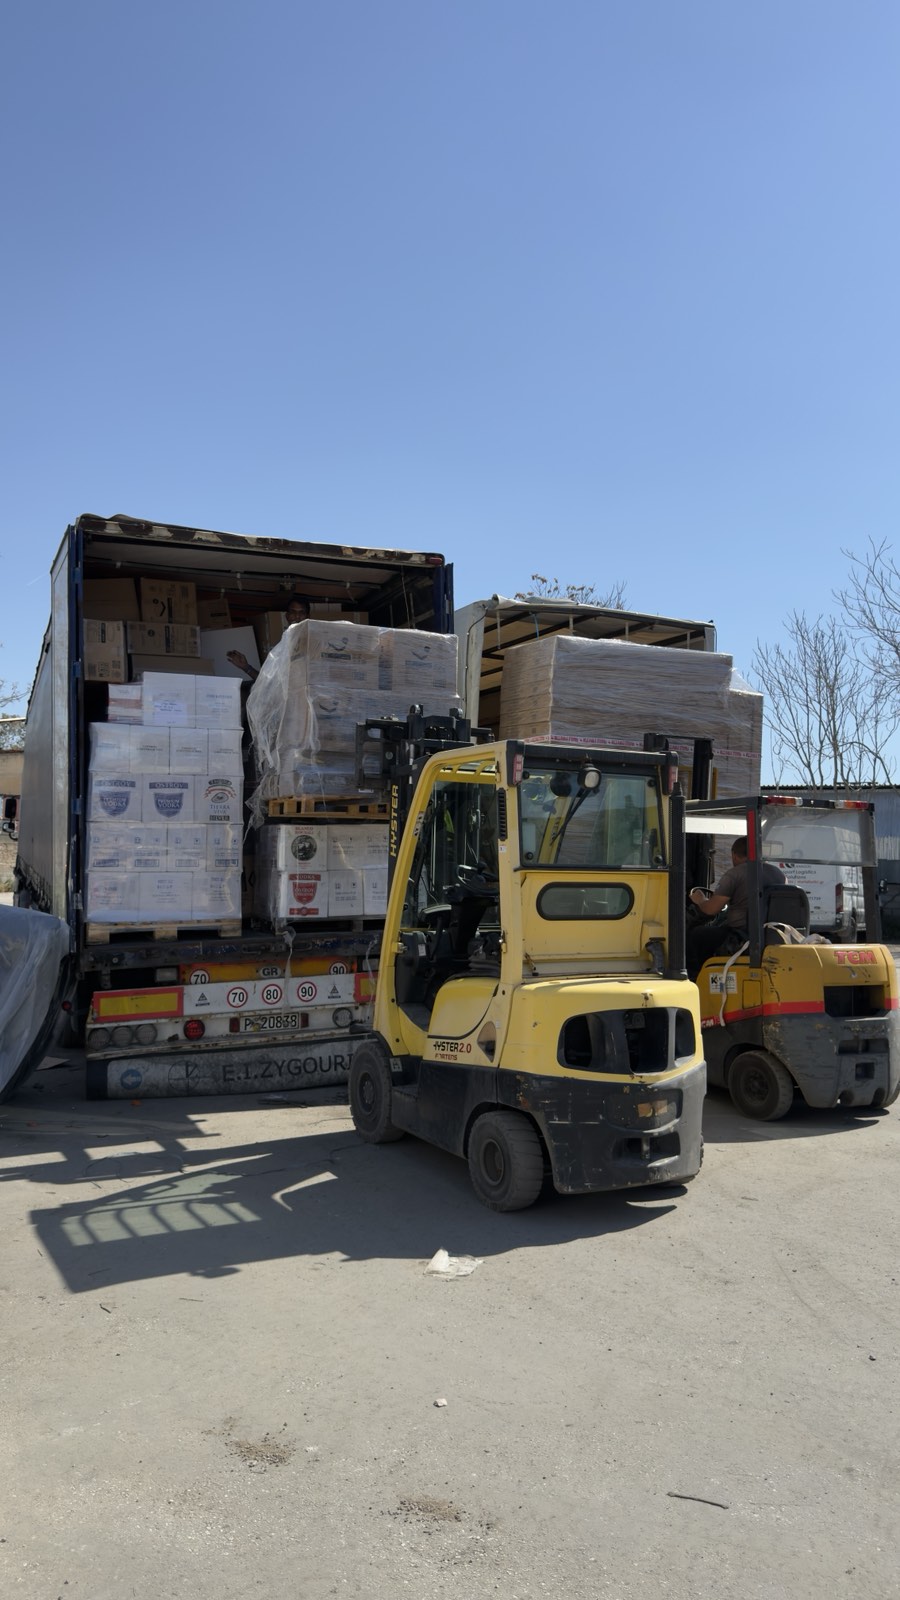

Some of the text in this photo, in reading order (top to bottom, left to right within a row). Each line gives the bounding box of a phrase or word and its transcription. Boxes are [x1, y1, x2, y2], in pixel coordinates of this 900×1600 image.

[390, 784, 399, 857] HYSTER
[834, 950, 878, 965] TCM
[262, 967, 279, 977] GR
[332, 963, 345, 975] 90
[193, 973, 207, 984] 70
[231, 991, 245, 1003] 70
[265, 988, 279, 1000] 80
[301, 986, 314, 998] 90
